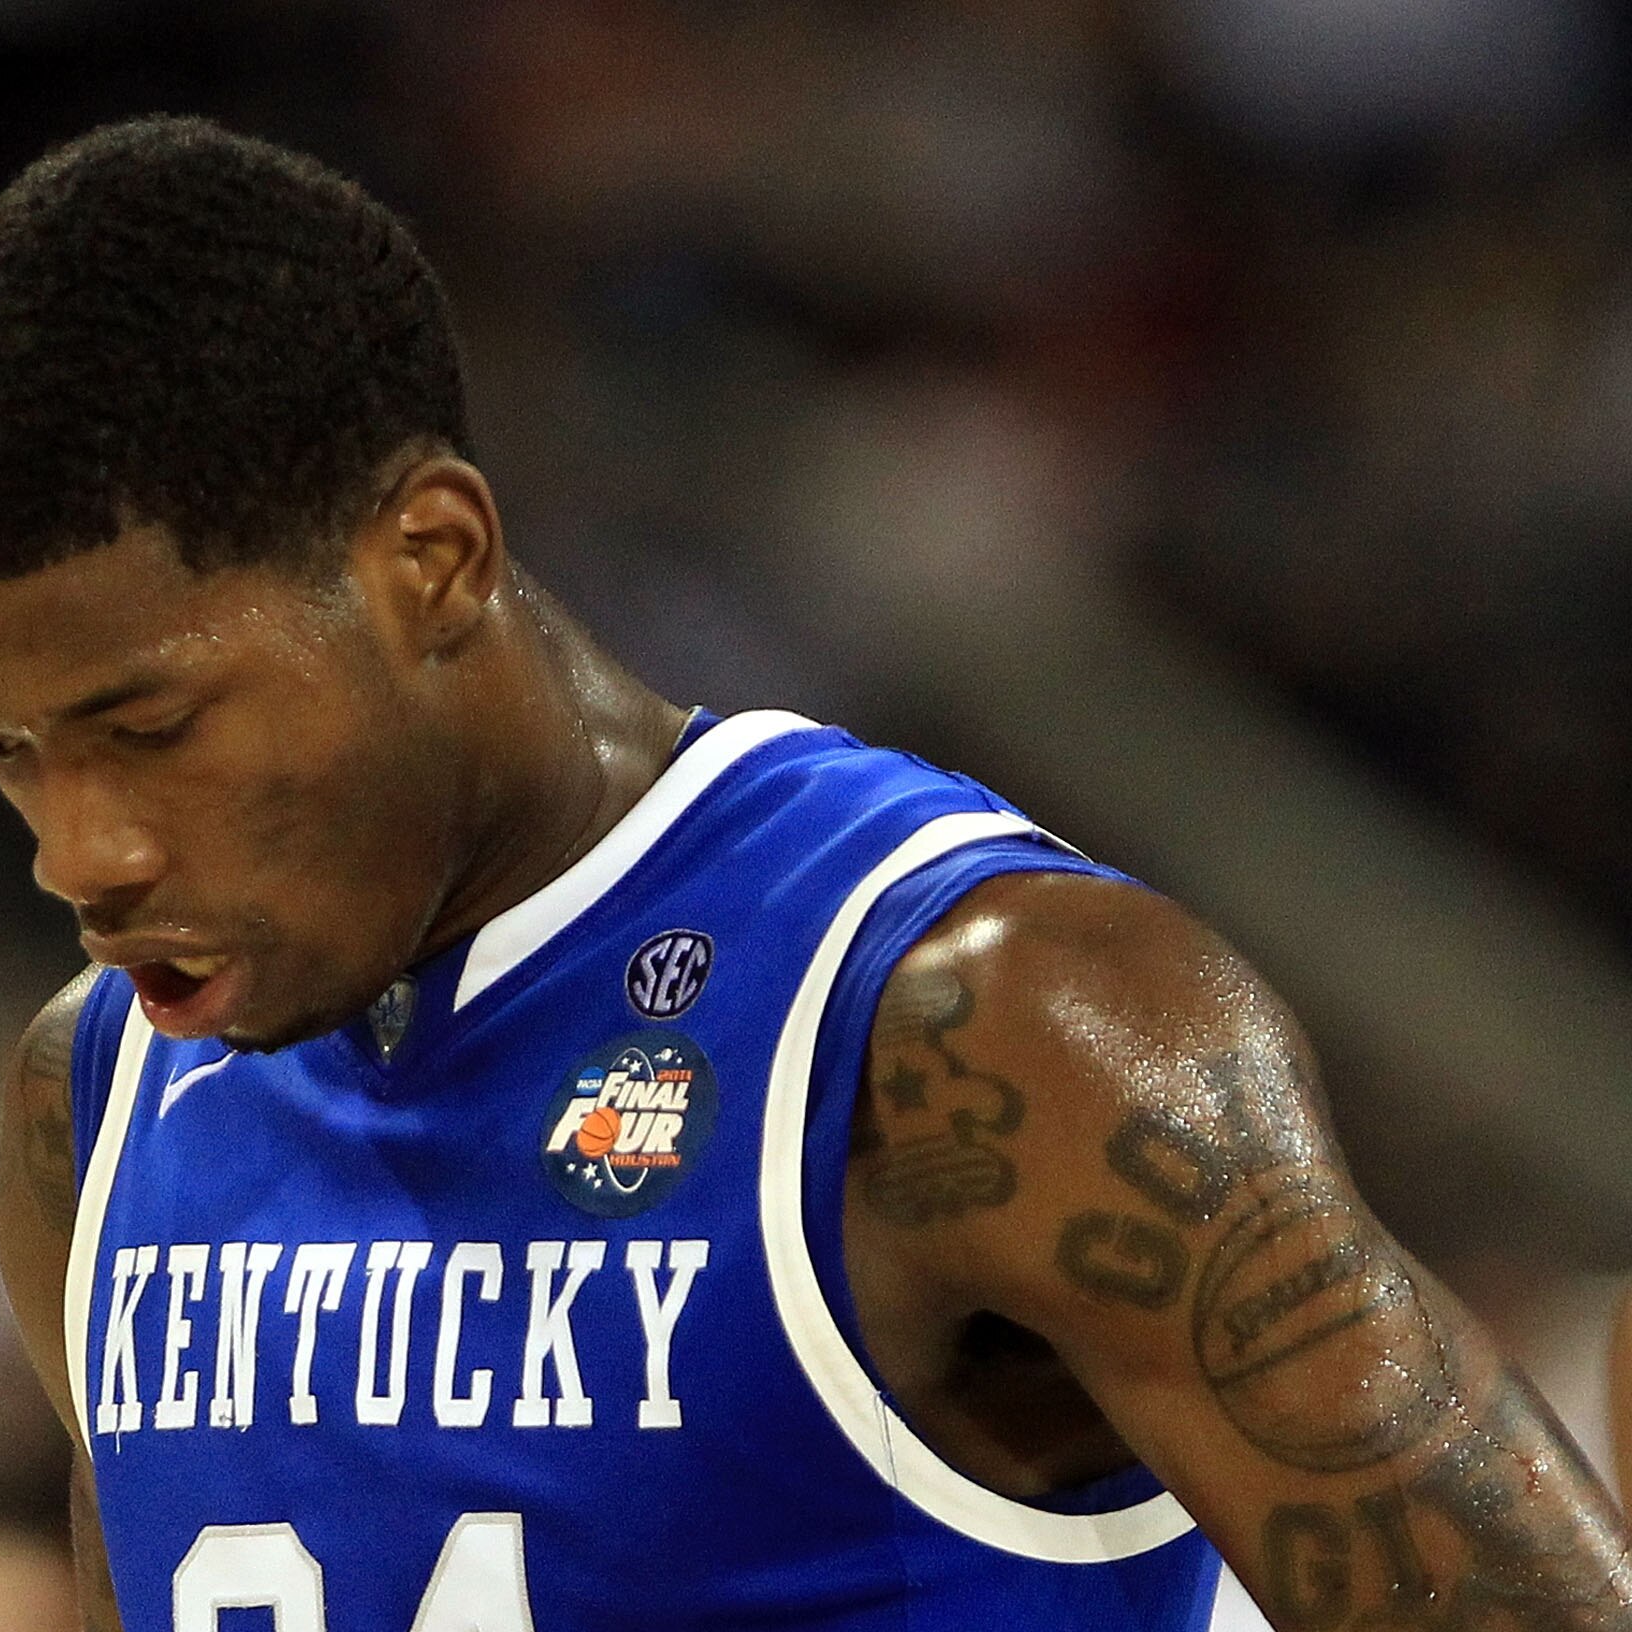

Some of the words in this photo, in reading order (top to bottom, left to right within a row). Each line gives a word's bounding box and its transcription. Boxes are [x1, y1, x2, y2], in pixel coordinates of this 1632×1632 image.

[633, 935, 708, 1012] SEC
[595, 1070, 690, 1111] FINAL
[95, 1239, 710, 1430] KENTUCKY
